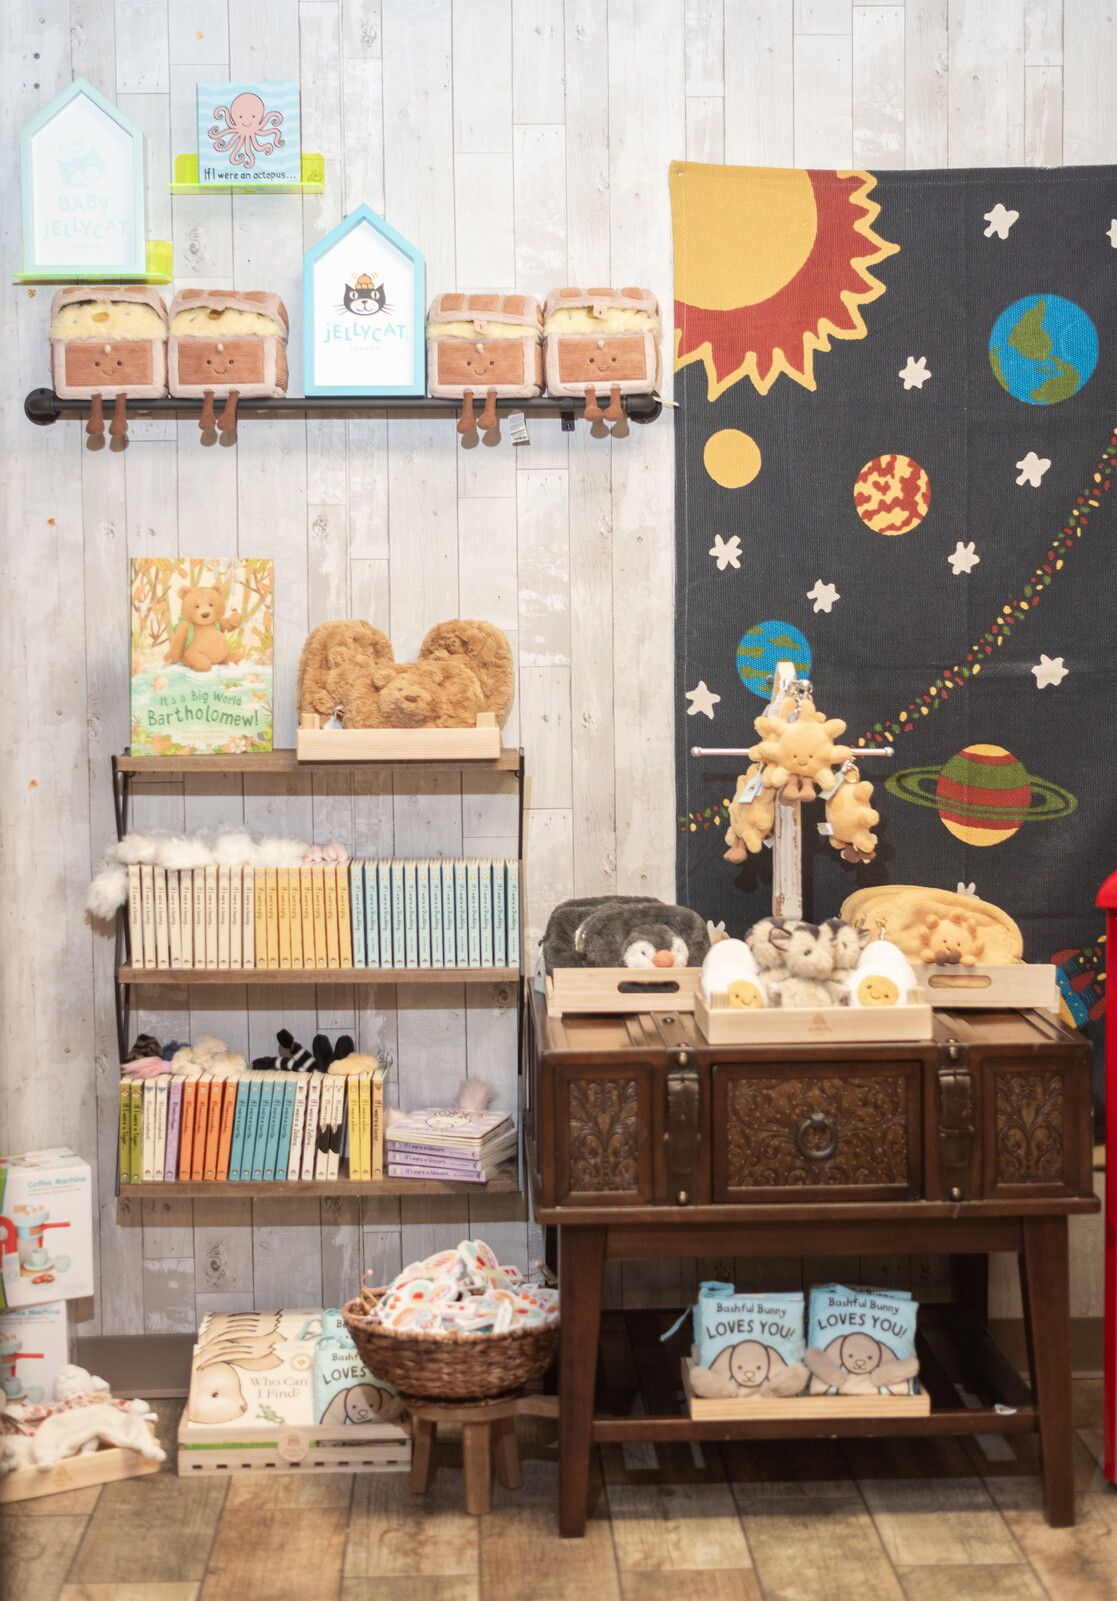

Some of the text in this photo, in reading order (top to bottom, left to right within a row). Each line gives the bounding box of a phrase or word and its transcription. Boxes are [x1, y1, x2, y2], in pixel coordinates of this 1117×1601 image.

[192, 690, 208, 704] Big
[214, 691, 242, 706] World
[148, 705, 259, 726] Bartholomew!
[28, 1180, 52, 1188] Coffee
[55, 1176, 86, 1184] Machine
[716, 1302, 786, 1318] Bashful Bunny
[828, 1296, 899, 1315] Bashful Bunny
[706, 1320, 796, 1340] LOVES YOU!
[818, 1312, 908, 1338] LOVES YOU!
[251, 1376, 308, 1386] Who Can
[322, 1366, 368, 1384] LOVES
